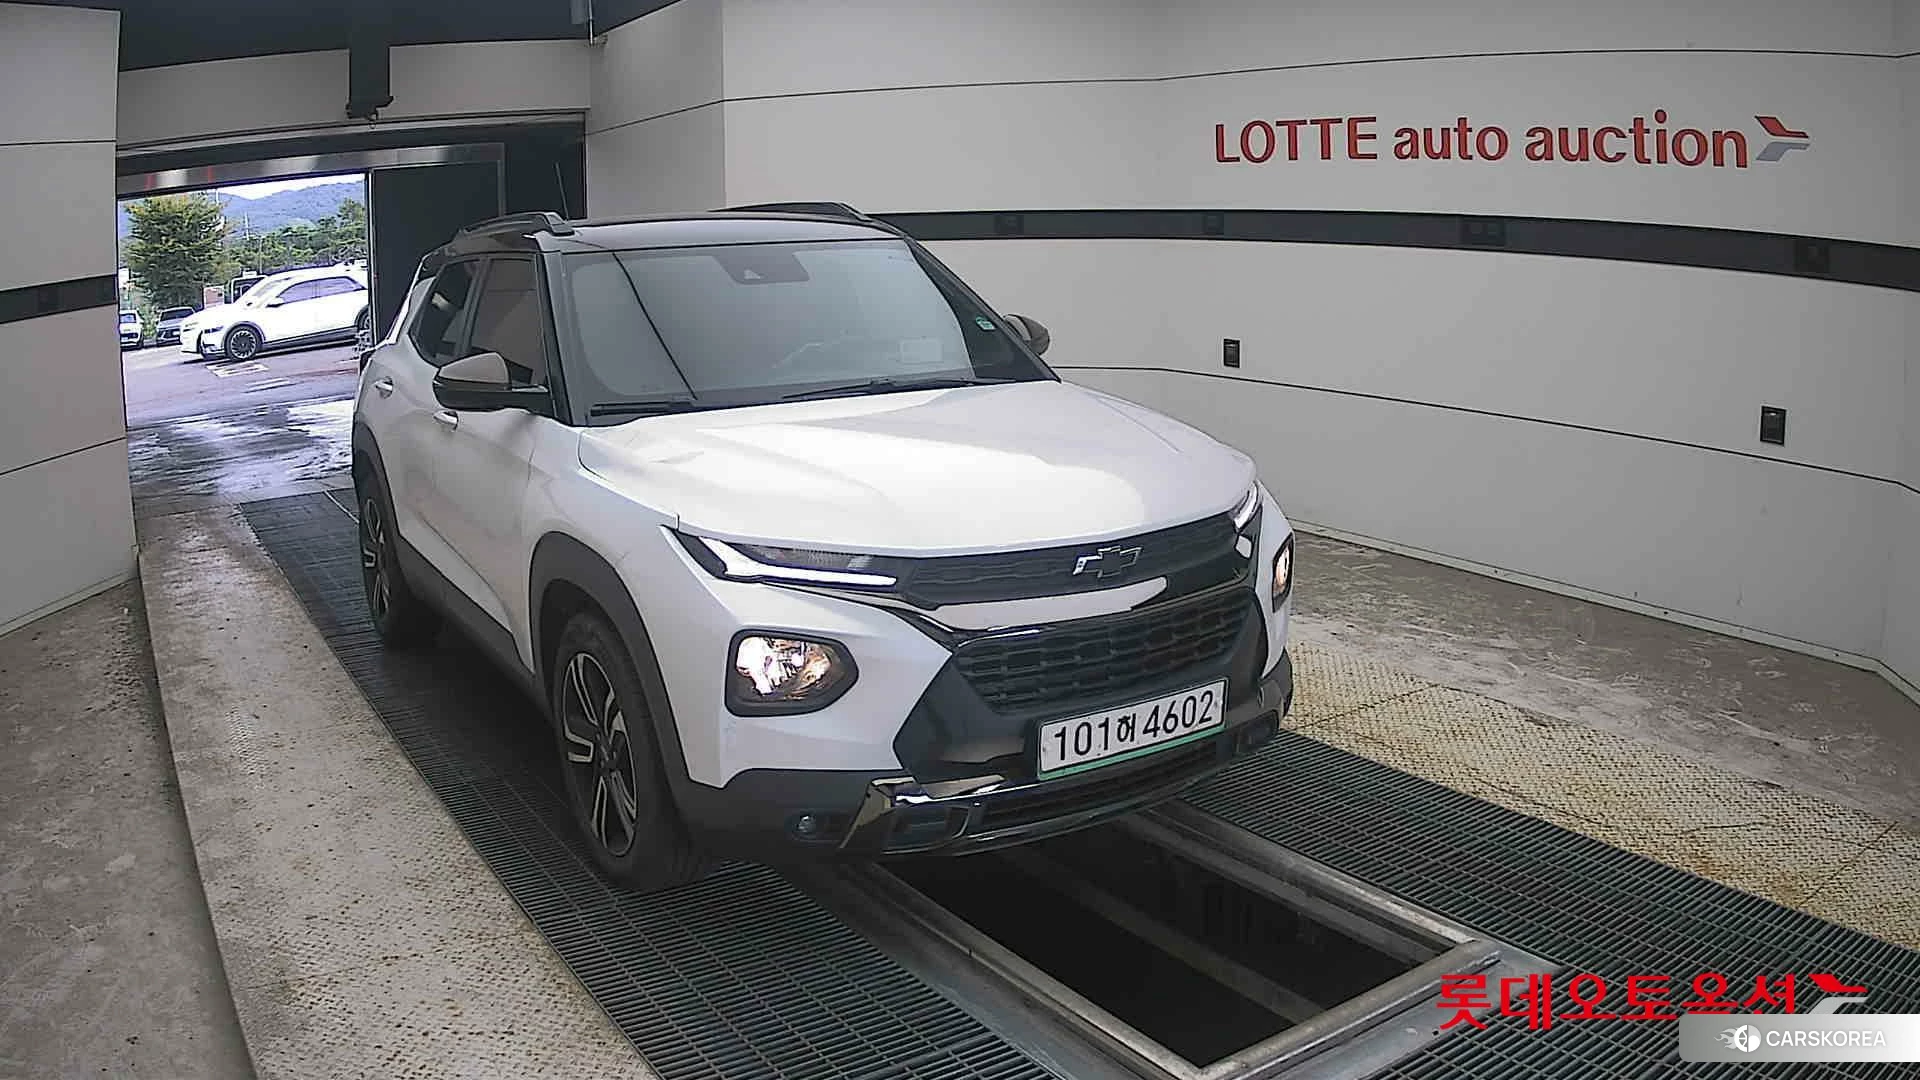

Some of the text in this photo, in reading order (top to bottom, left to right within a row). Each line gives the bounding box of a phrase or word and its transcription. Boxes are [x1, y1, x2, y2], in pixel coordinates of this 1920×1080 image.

[1215, 109, 1749, 169] LOTTE auto auction
